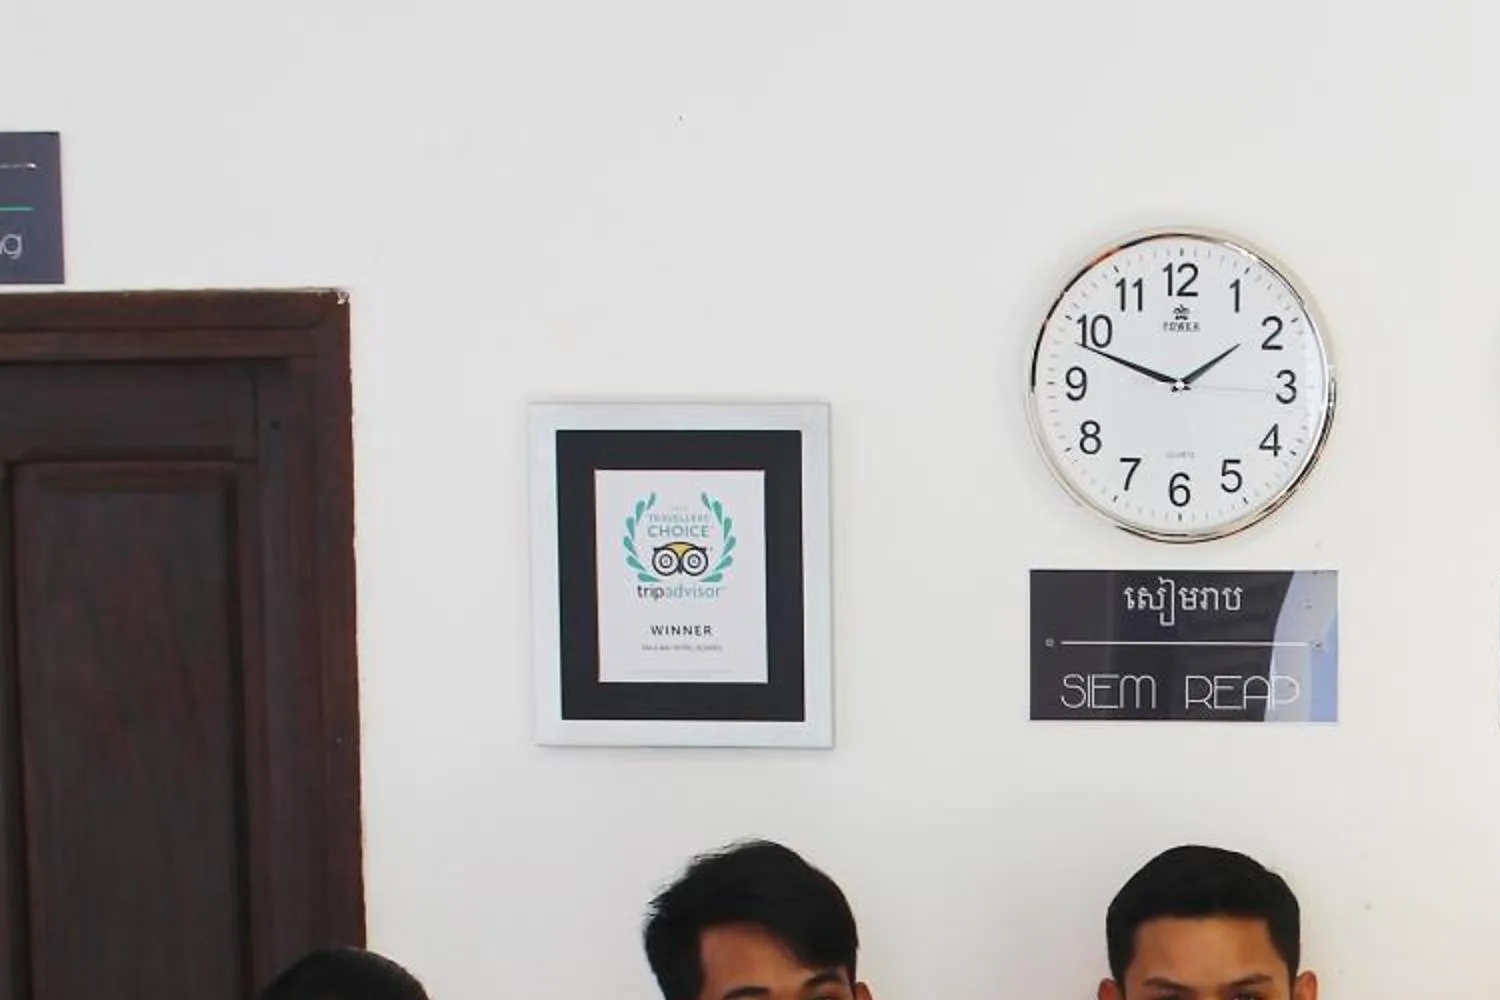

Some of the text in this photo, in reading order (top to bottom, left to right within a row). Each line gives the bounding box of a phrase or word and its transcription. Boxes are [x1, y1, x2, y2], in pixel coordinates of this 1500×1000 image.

[1115, 277, 1143, 313] 11
[1162, 262, 1199, 297] 12
[1229, 278, 1240, 314] 1
[1076, 313, 1113, 349] 10
[1261, 315, 1284, 351] 2
[1065, 366, 1088, 402] 9
[1275, 369, 1297, 405] 3
[1079, 420, 1102, 455] 8
[1258, 423, 1283, 458] 4
[1119, 457, 1142, 492] 7
[1168, 471, 1191, 508] 6
[1220, 458, 1243, 494] 5
[648, 525, 709, 538] CHOICE
[637, 584, 721, 600] tripadvisor
[650, 624, 713, 637] WINNER
[1061, 674, 1300, 711] SIEM REAP
